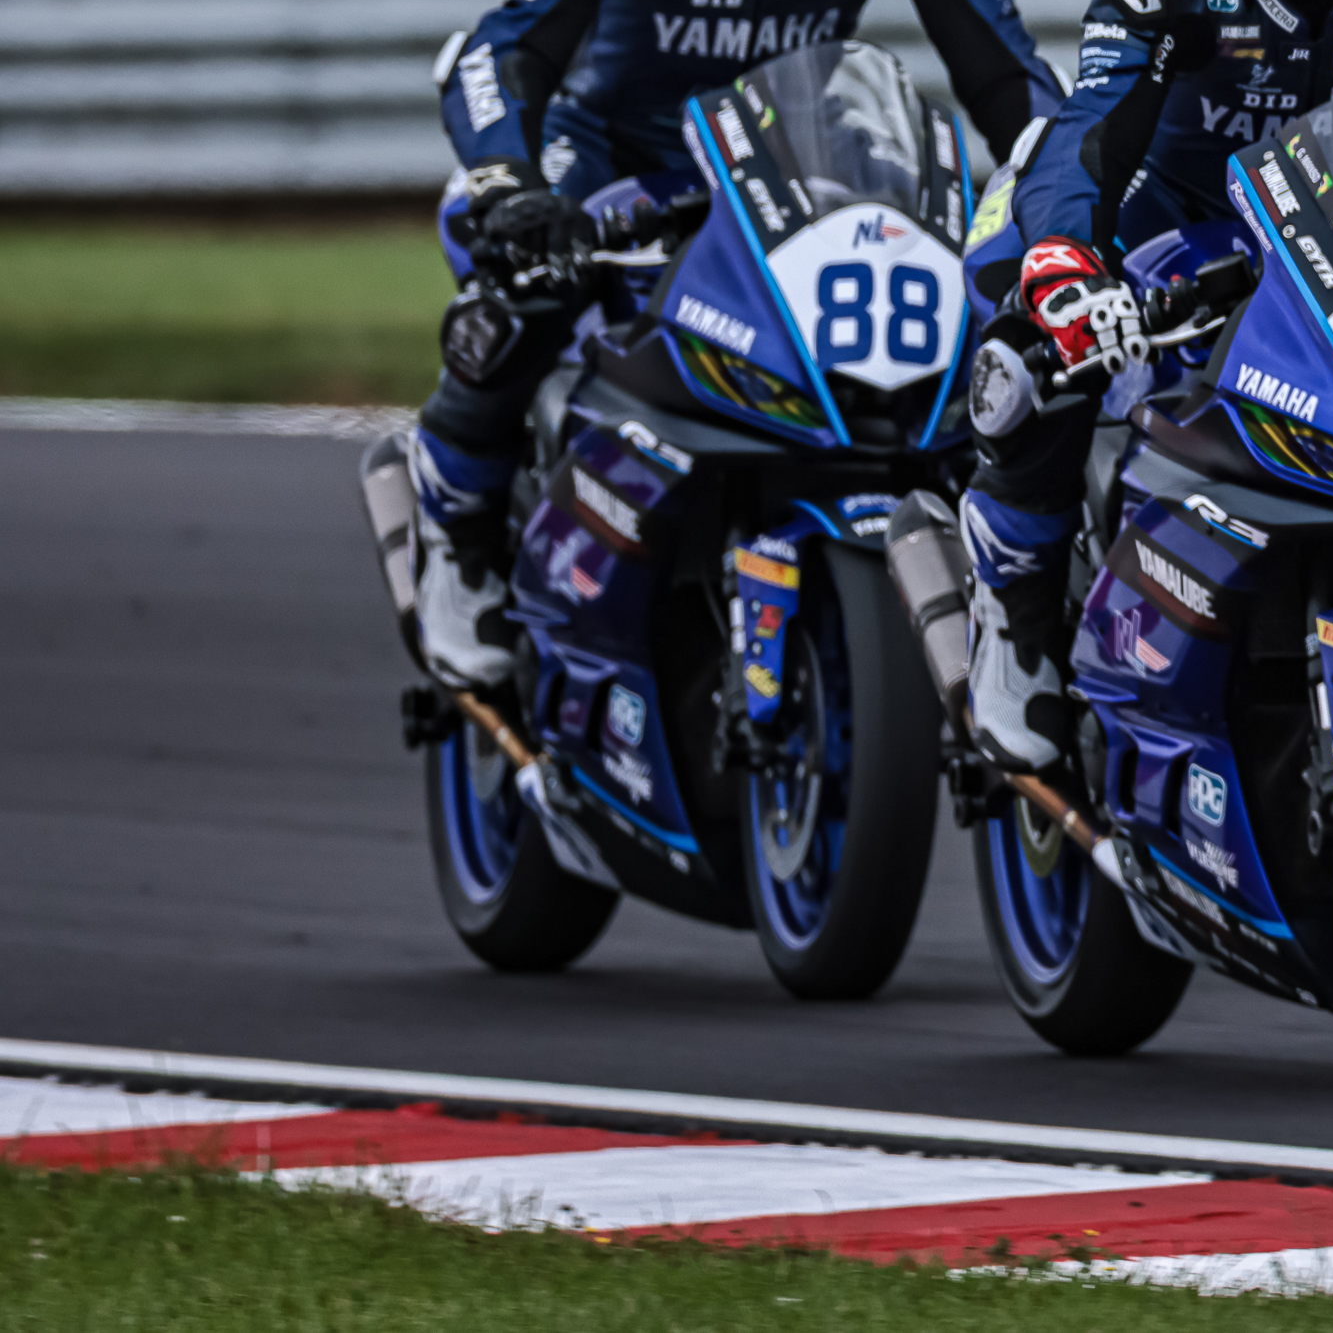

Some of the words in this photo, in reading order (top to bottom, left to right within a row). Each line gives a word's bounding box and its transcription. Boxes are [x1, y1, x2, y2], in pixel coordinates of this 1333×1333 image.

[654, 9, 840, 63] YAMAHA
[676, 294, 757, 356] YAMAHA
[815, 261, 940, 367] 88
[1235, 364, 1320, 423] YAMAHA
